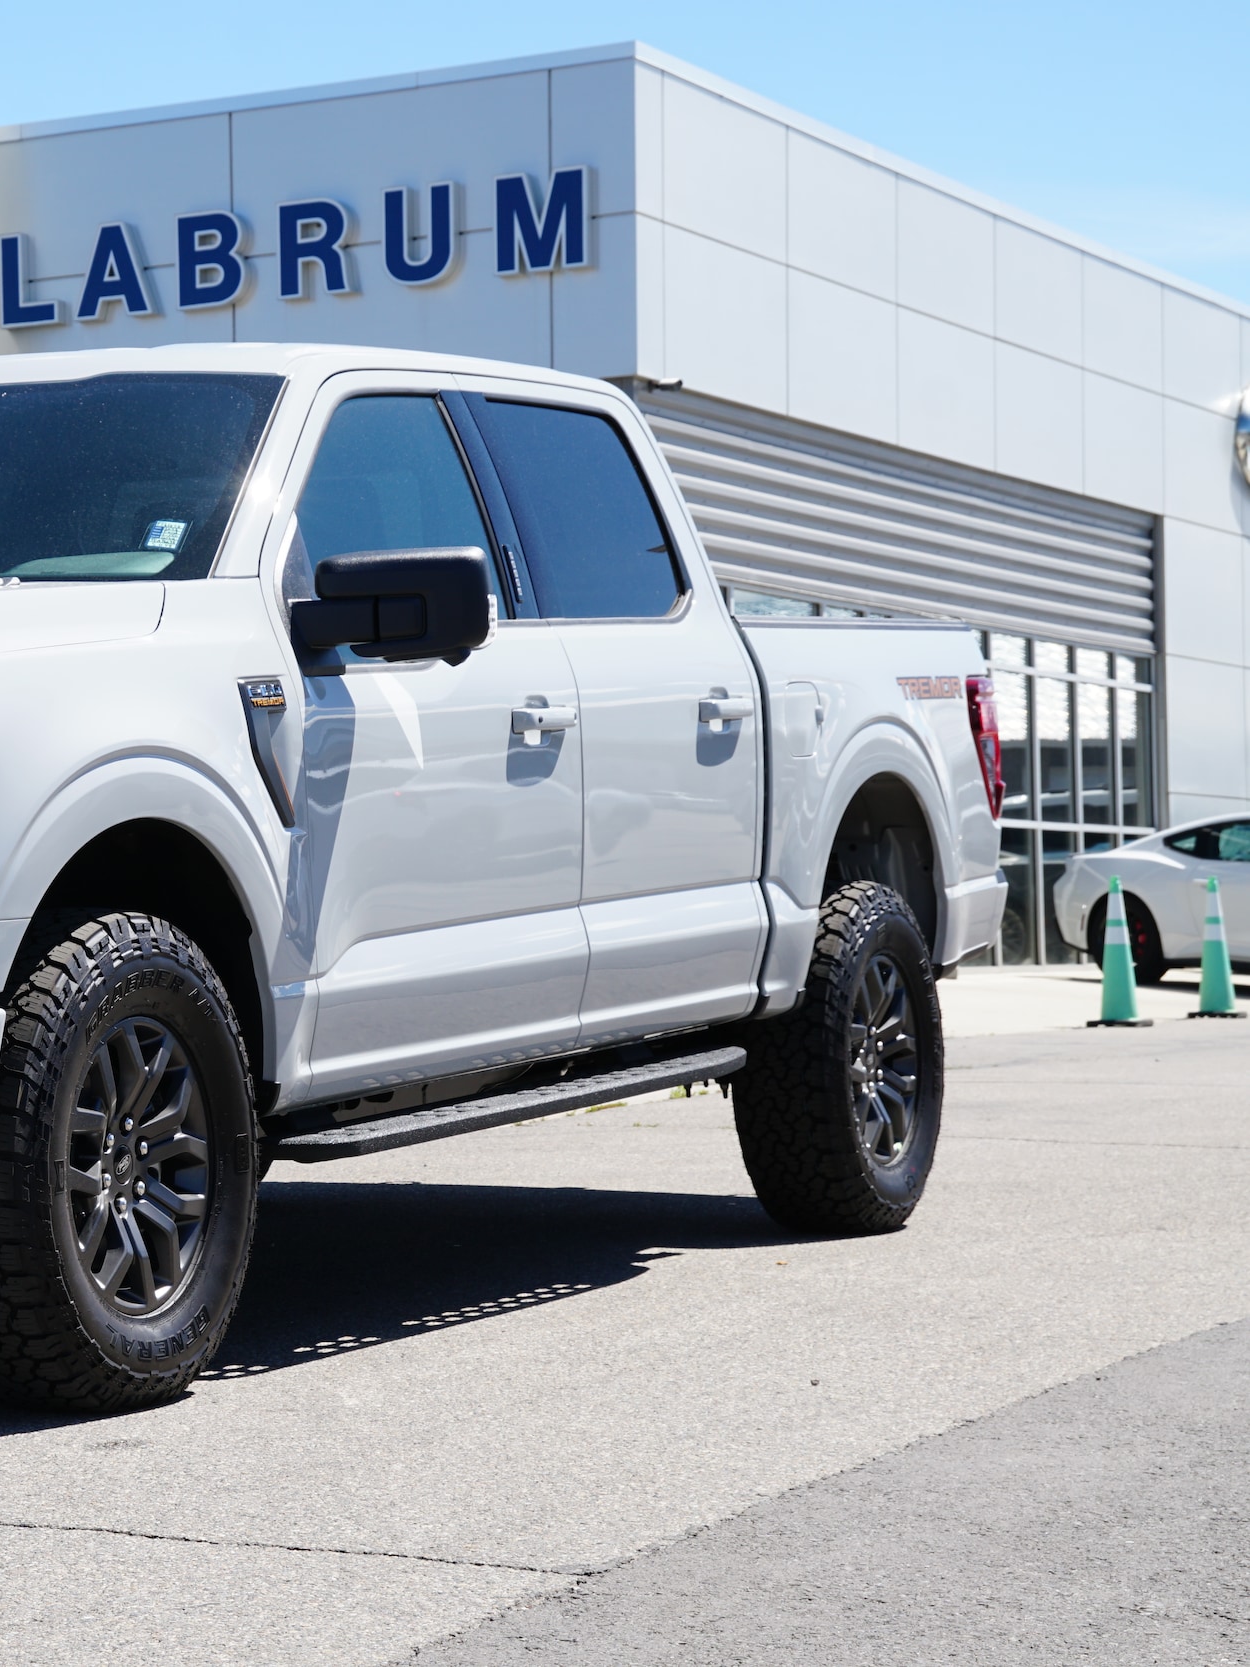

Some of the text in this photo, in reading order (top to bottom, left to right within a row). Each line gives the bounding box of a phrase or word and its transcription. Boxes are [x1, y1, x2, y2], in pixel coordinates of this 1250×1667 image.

[250, 696, 286, 707] TREMOR
[895, 675, 964, 700] TREMOR
[85, 968, 184, 1045] GRABBER
[105, 1303, 210, 1360] GENERAL
